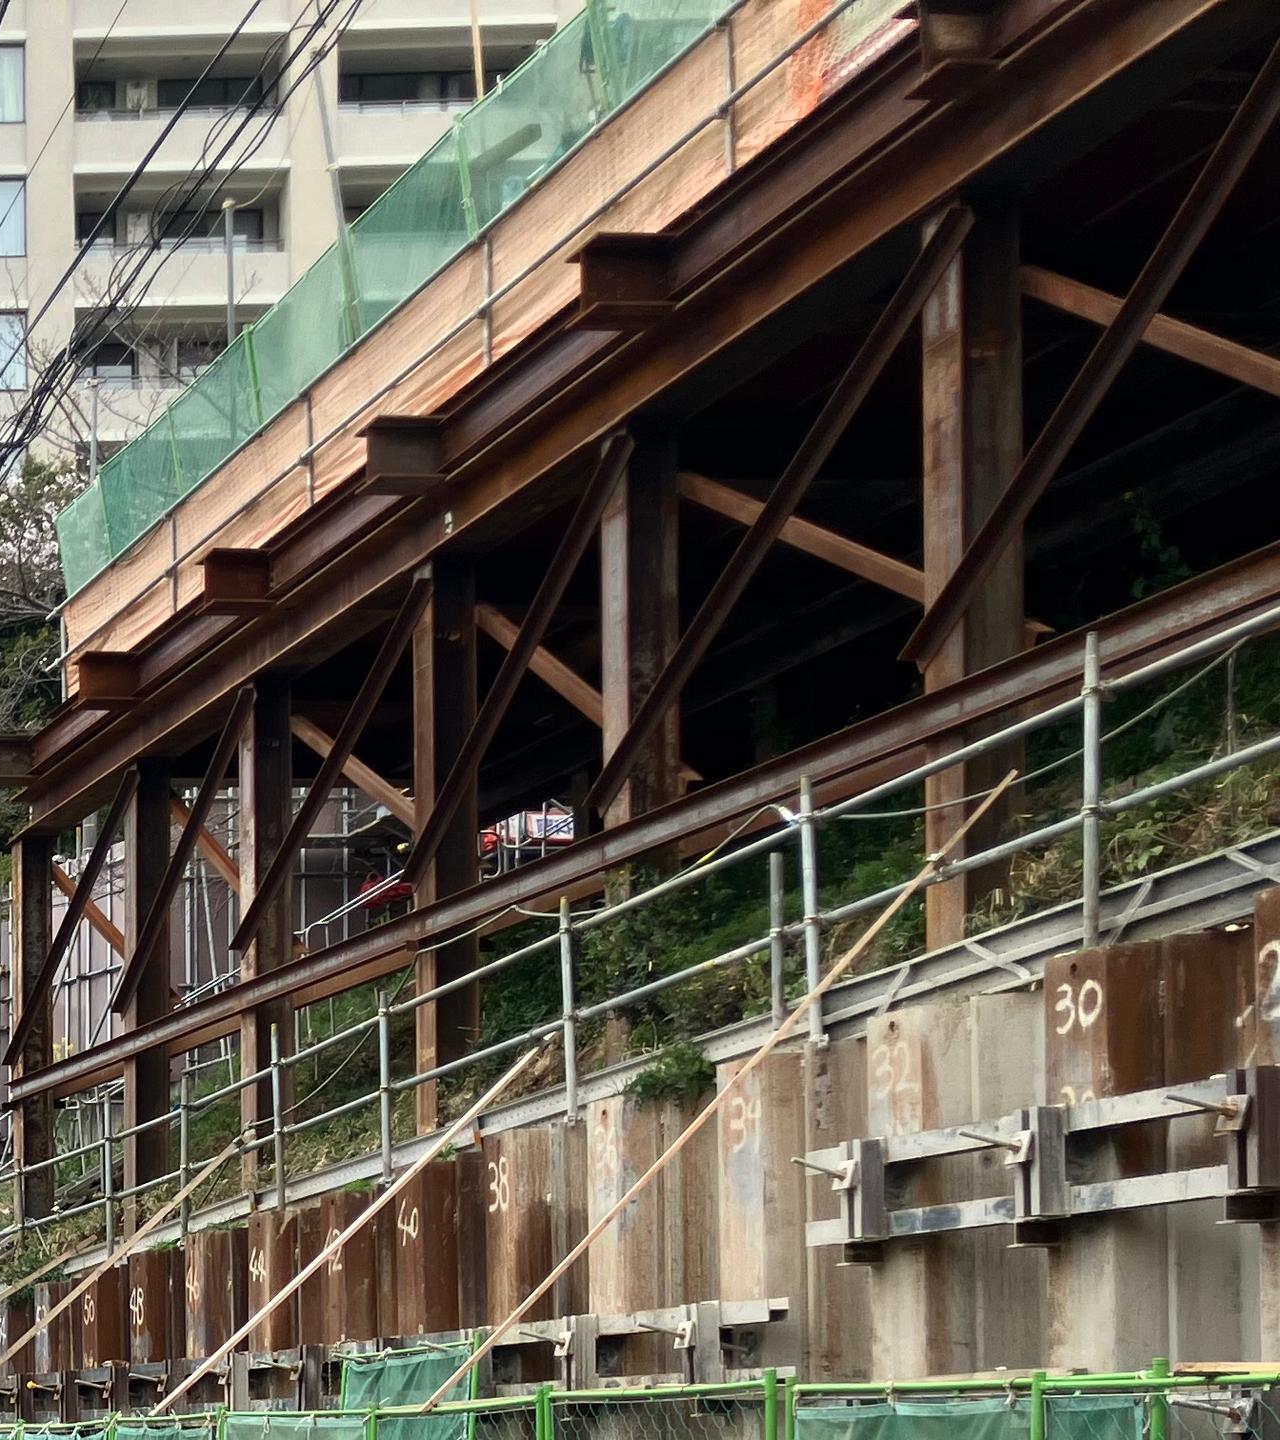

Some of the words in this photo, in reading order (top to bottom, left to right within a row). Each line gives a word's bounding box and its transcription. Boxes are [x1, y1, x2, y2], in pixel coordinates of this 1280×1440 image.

[1056, 979, 1103, 1035] 30
[488, 1156, 510, 1213] 38
[397, 1198, 419, 1247] 40
[249, 1246, 267, 1282] 44
[83, 1294, 95, 1325] 50
[130, 1287, 144, 1325] 48
